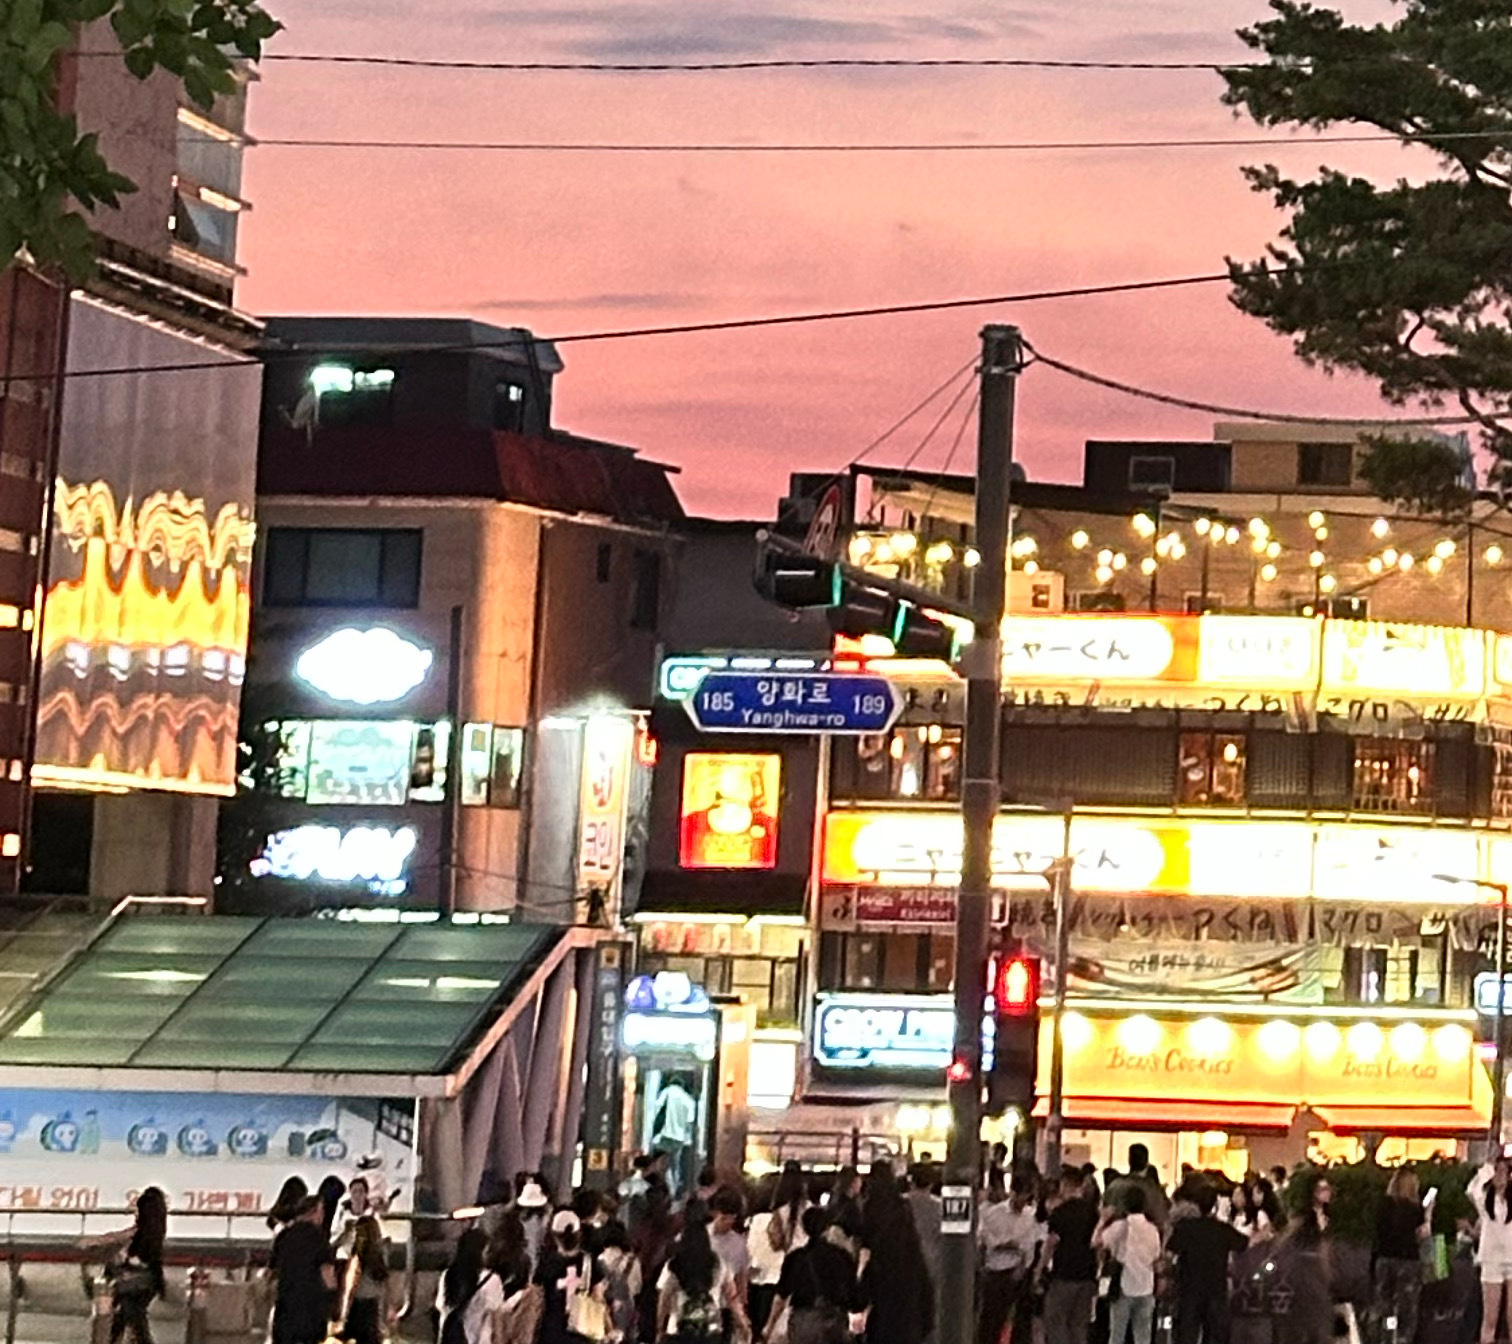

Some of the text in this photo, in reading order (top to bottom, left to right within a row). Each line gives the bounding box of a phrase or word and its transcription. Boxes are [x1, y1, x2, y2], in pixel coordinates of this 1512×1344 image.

[702, 691, 735, 711] 185
[756, 680, 832, 706] 양화로
[852, 695, 886, 715] 189
[742, 708, 846, 729] Yanghwa-ro
